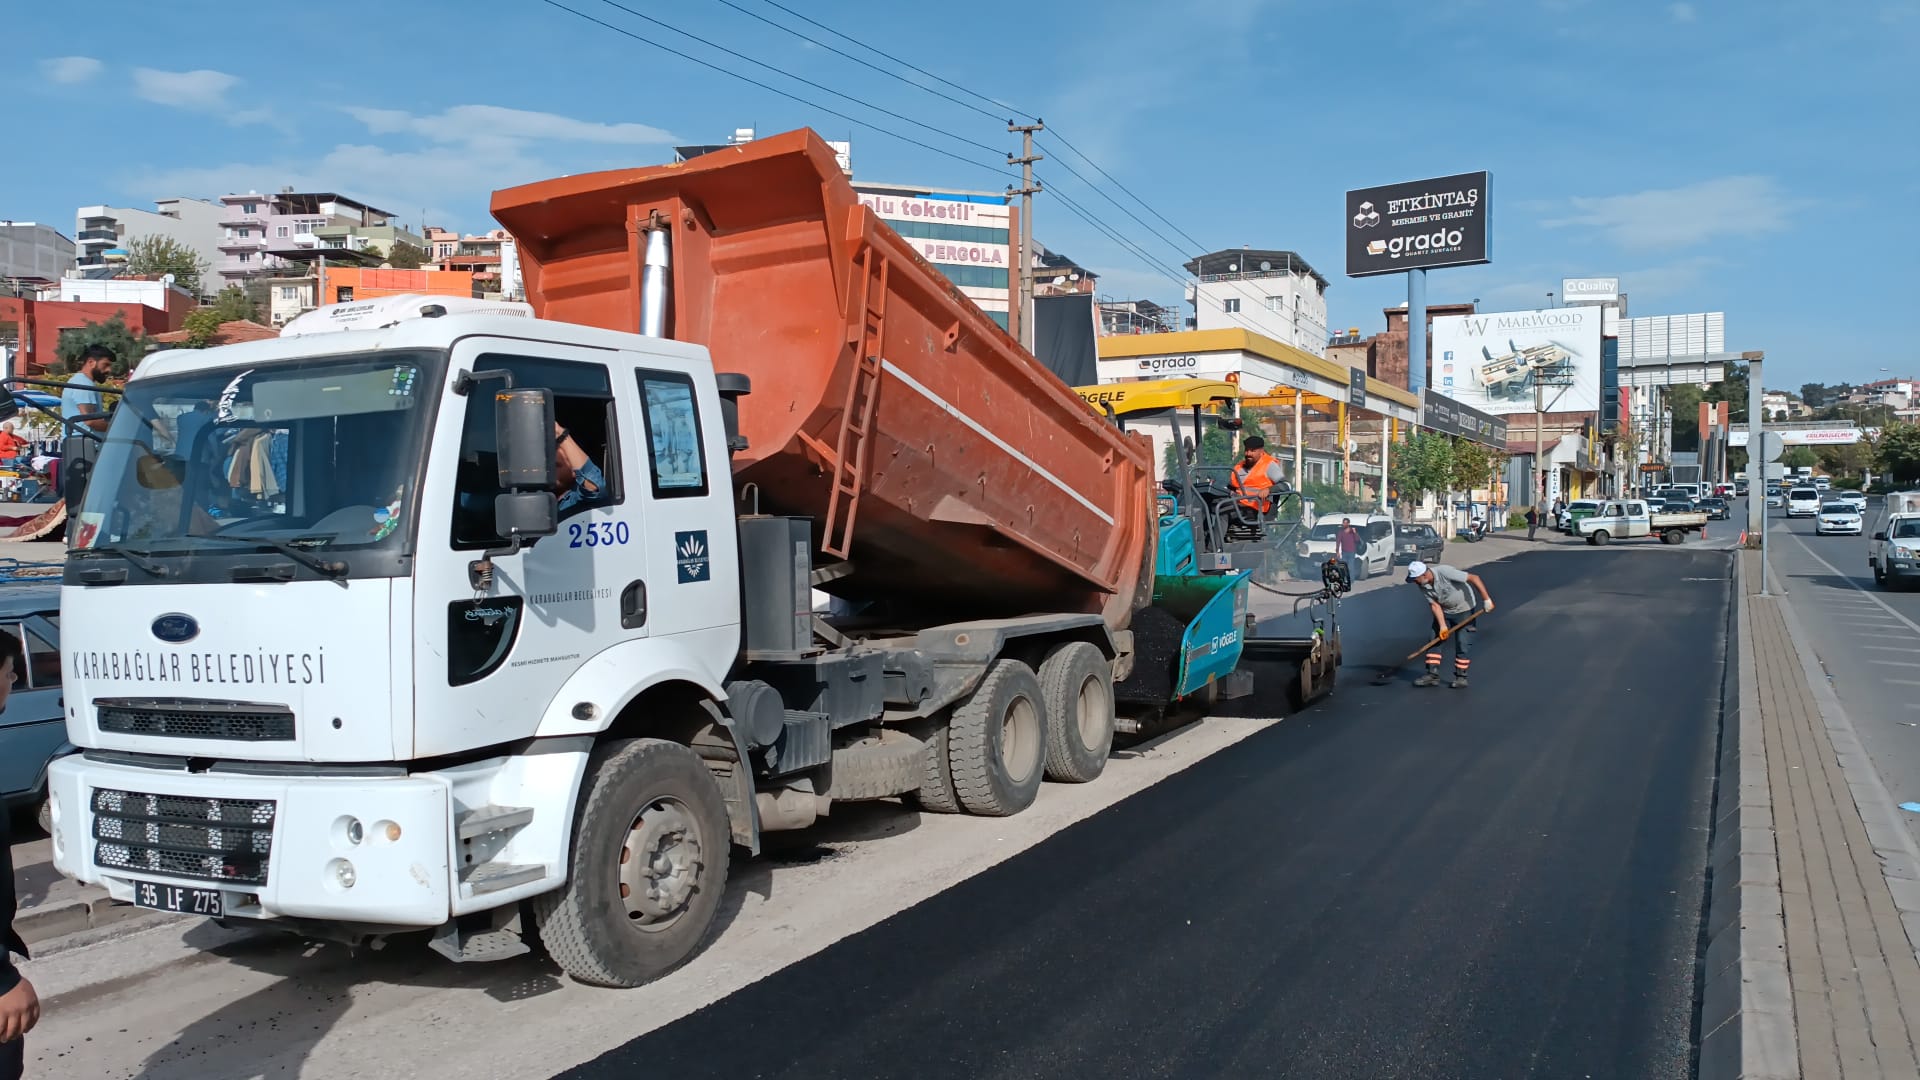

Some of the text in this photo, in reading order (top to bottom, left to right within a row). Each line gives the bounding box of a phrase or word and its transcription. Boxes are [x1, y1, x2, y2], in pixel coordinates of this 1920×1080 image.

[901, 200, 969, 221] tekstil
[1387, 189, 1478, 214] ETKİNTAŞ
[1392, 215, 1428, 226] MERMER
[1429, 213, 1440, 221] VE
[925, 244, 1003, 263] PERGOLA
[1388, 227, 1463, 259] grado
[1578, 281, 1615, 292] Quality
[1152, 355, 1196, 373] grado
[1079, 391, 1126, 404] ÖGELE
[568, 521, 629, 548] 2530
[73, 646, 325, 684] KARABAĞLAR BELEDİYESİ
[142, 883, 220, 914] 35 LF 275
